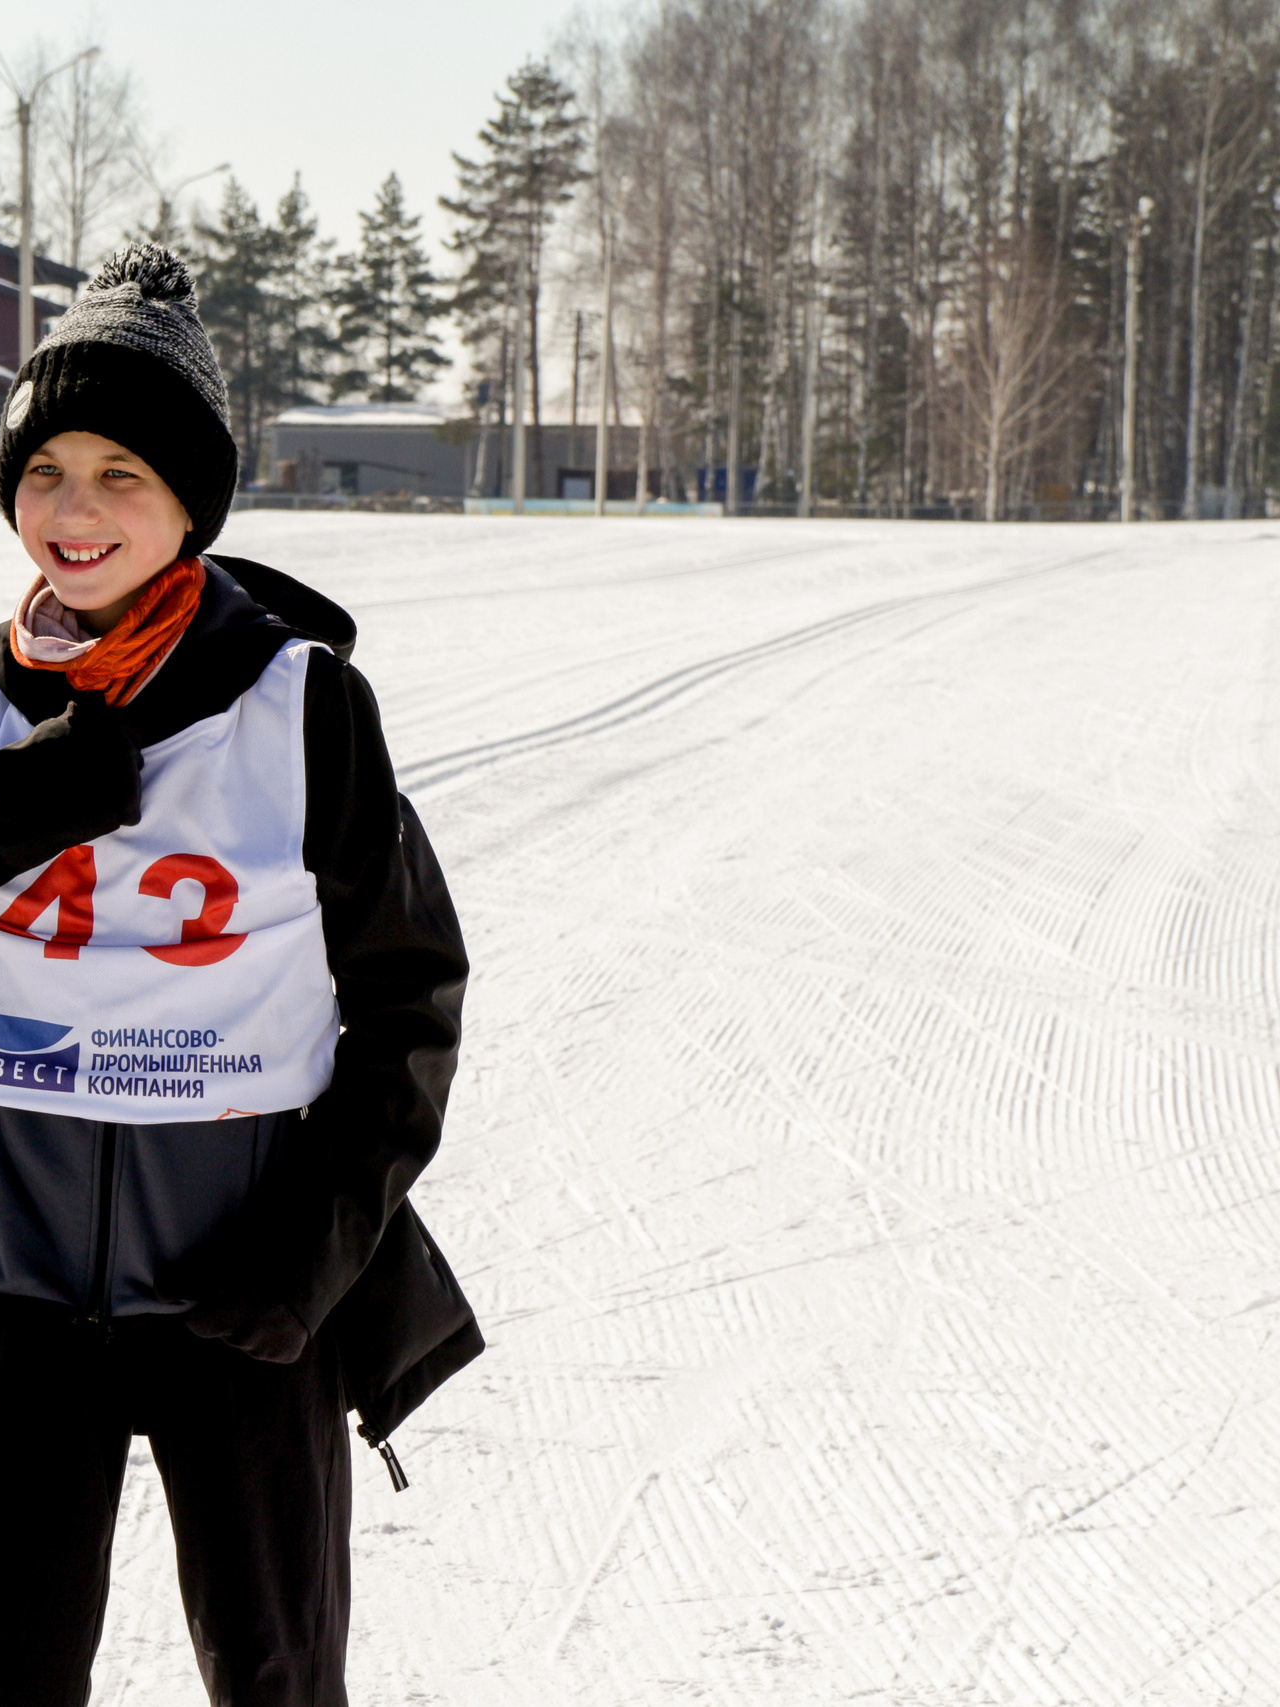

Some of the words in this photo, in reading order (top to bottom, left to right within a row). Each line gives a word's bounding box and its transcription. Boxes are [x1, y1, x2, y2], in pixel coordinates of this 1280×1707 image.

[91, 1028, 225, 1048] ФИНАНСОВО-
[91, 1053, 263, 1073] ПРОМЫШЛЕННАЯ
[87, 1075, 205, 1099] КОМПАНИЯ
